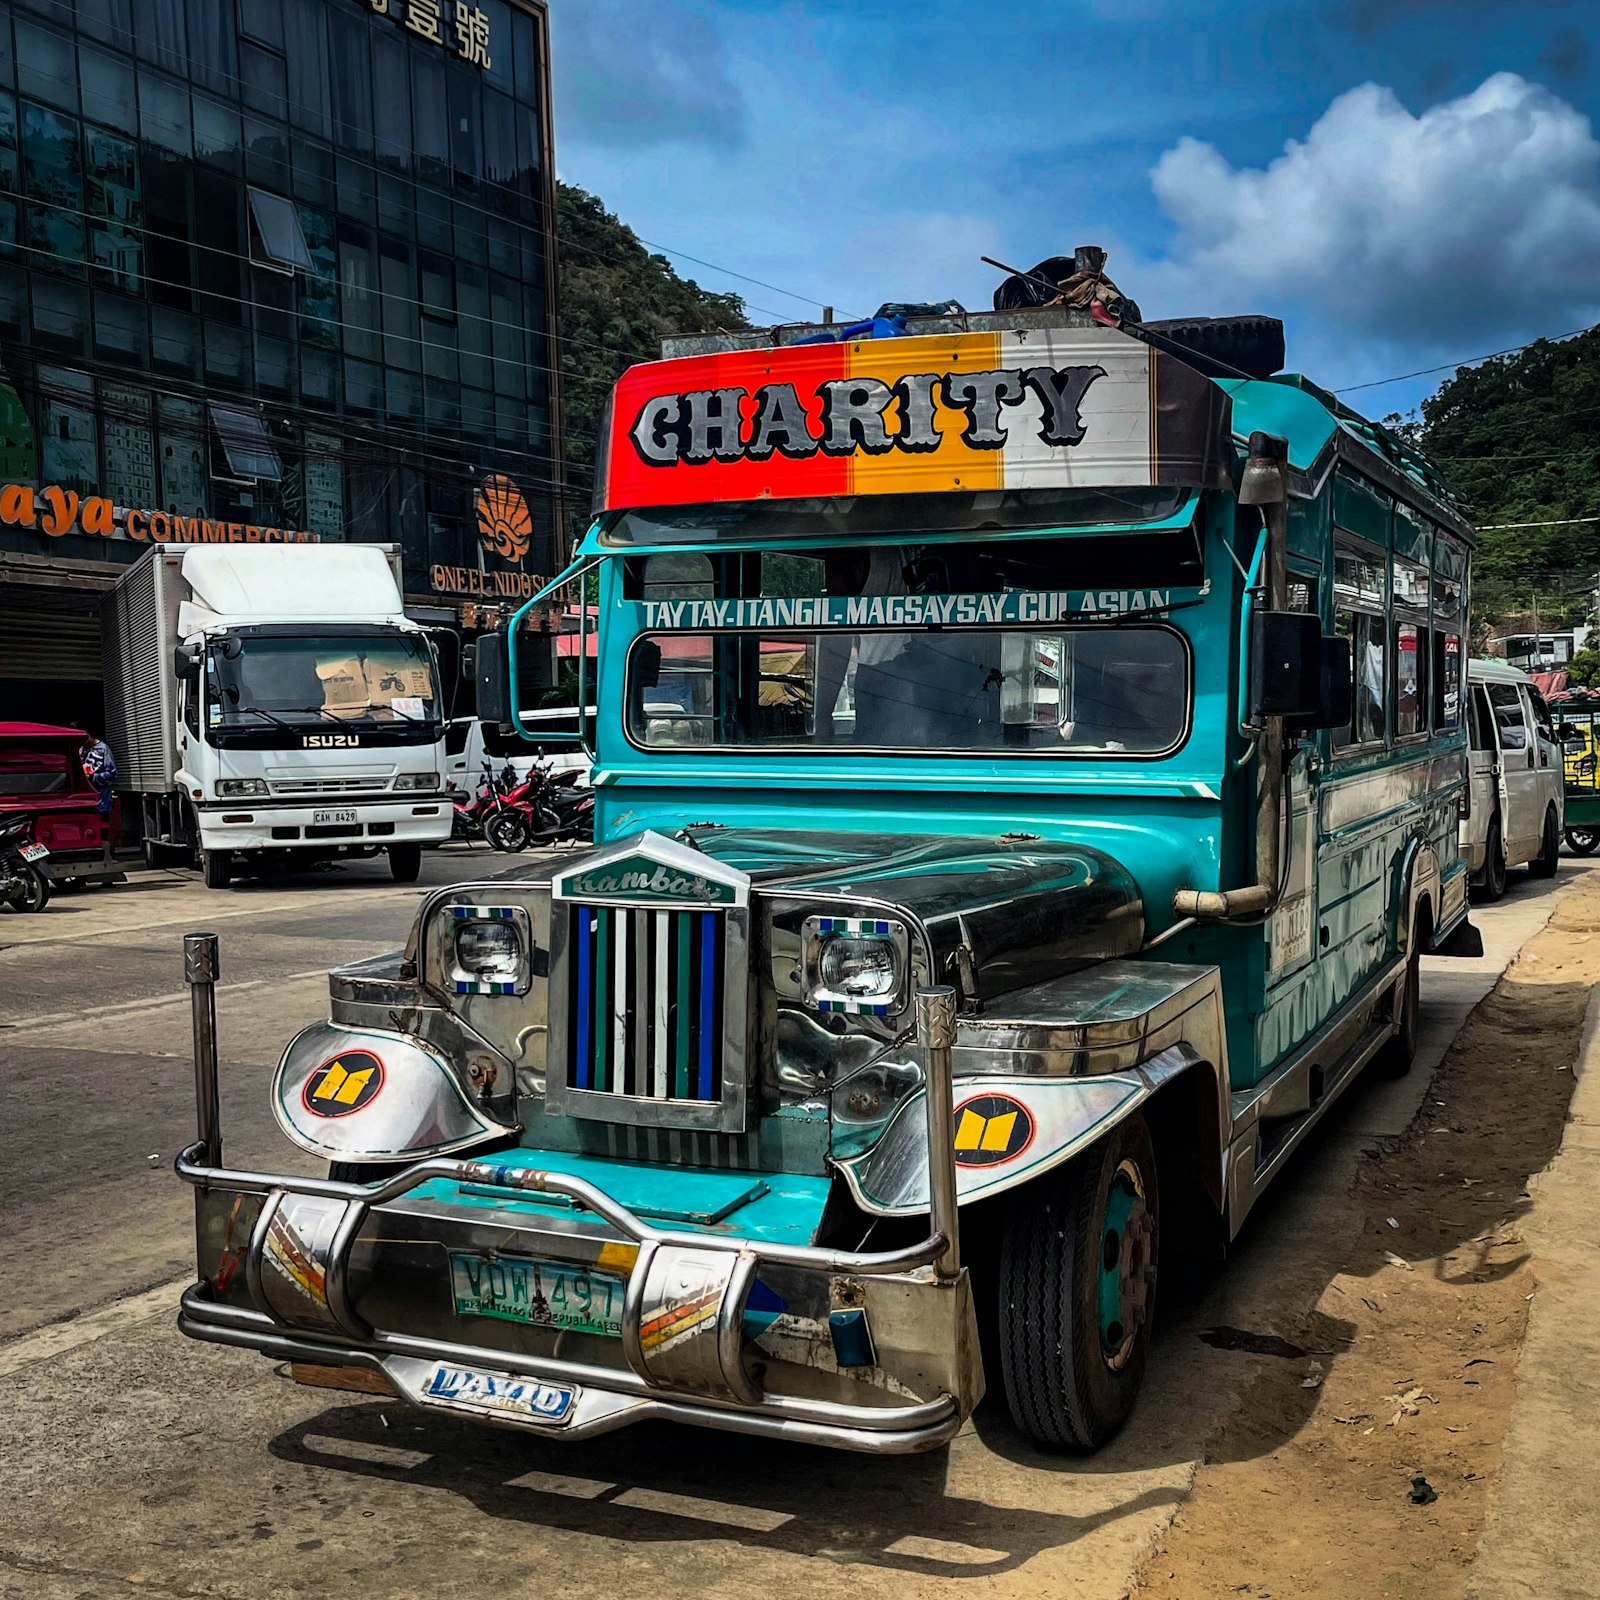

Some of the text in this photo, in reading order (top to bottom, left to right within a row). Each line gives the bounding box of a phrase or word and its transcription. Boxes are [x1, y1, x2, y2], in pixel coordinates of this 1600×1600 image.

[629, 366, 1108, 468] CHARITY
[302, 734, 360, 748] ISUZU
[315, 812, 356, 822] CAH 8429
[546, 1313, 604, 1330] EPUBLIKA
[436, 1367, 564, 1413] DAVID
